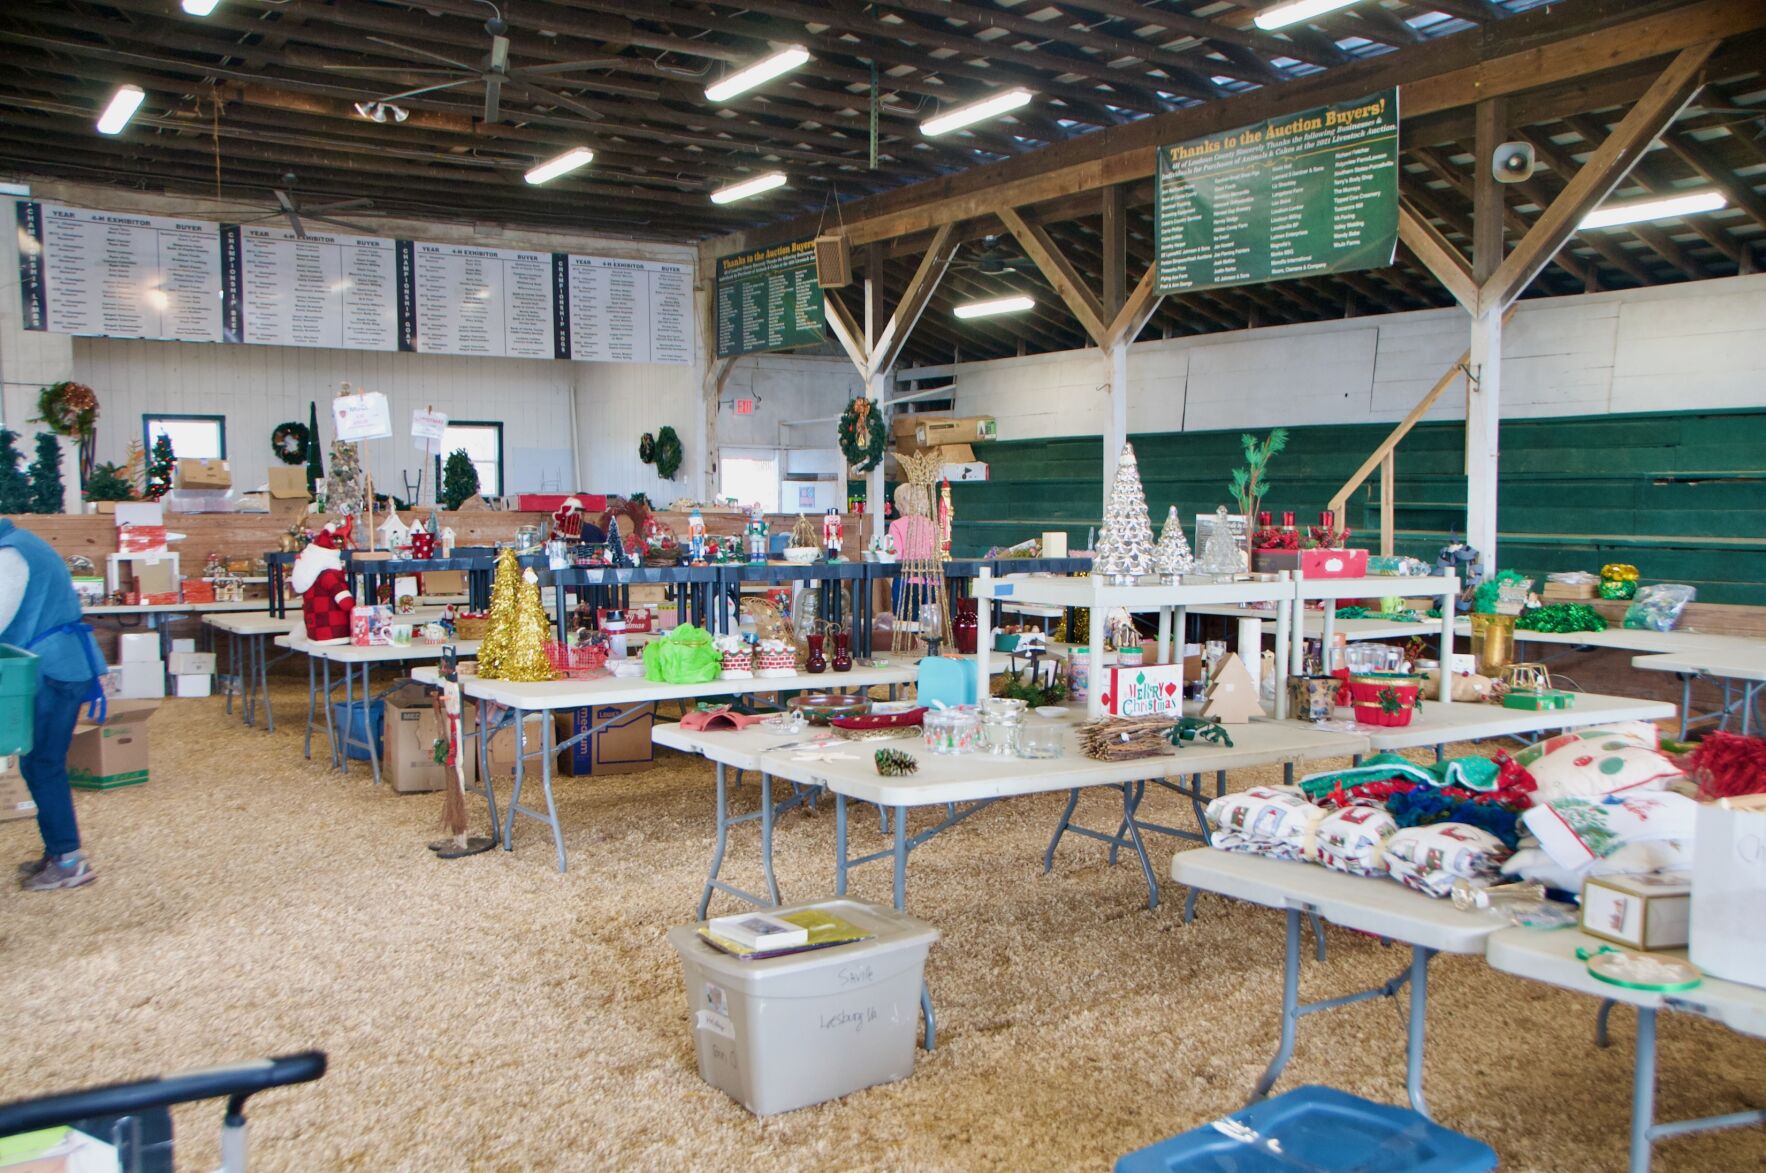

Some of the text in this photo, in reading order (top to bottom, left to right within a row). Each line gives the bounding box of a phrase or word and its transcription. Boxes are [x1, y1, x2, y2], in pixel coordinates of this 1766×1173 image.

[1171, 98, 1385, 160] Thanks to the Auction Buyers!
[1266, 138, 1291, 149] Thanks
[1304, 129, 1336, 141] following
[1242, 152, 1268, 163] Animals
[1332, 129, 1366, 143] Livestock
[52, 210, 76, 218] YEAR
[106, 216, 151, 227] EXHIBITOR
[175, 223, 203, 232] BUYER
[356, 239, 380, 247] BUYER
[464, 249, 498, 258] EXHIBITOR
[613, 261, 645, 270] EXHIBITOR
[723, 257, 746, 270] Thanks
[766, 245, 791, 260] Auction
[228, 231, 238, 306] CHAMPIONSHIP
[403, 248, 411, 318] CHAMPIONSHIP
[737, 399, 753, 414] EXIT
[1129, 682, 1165, 700] MERRY
[1122, 698, 1177, 716] Christmas
[580, 707, 588, 755] medum
